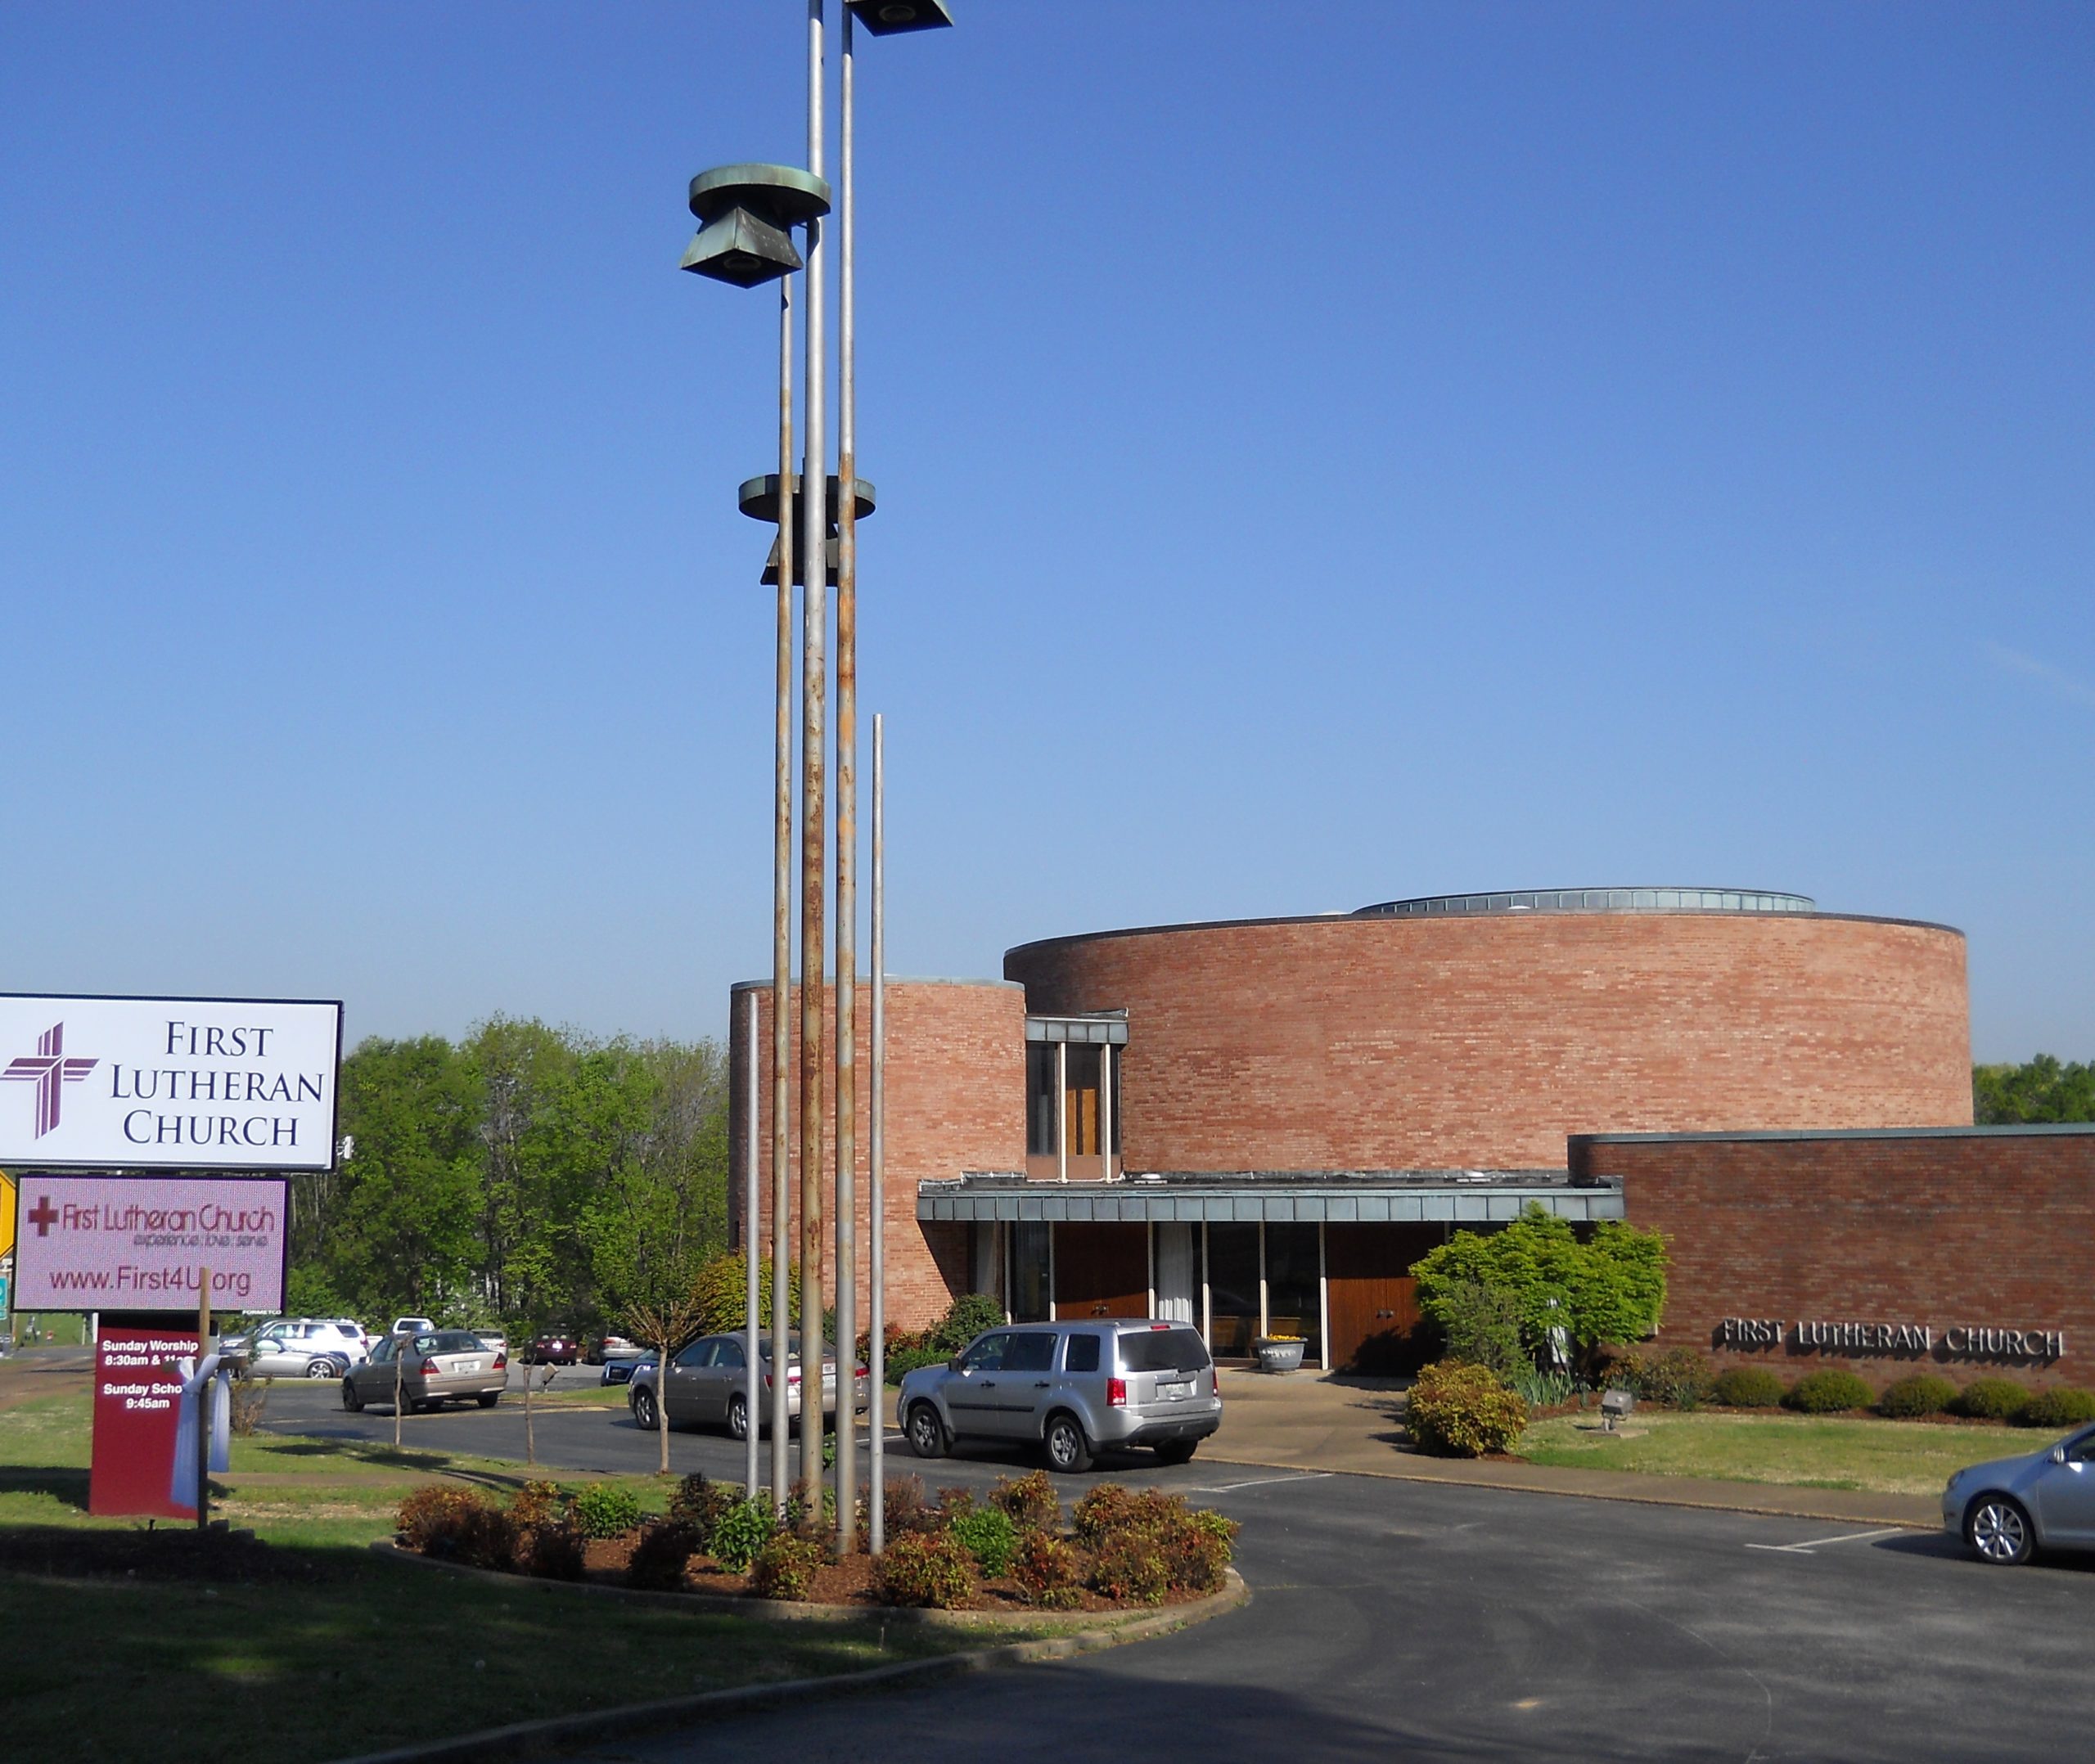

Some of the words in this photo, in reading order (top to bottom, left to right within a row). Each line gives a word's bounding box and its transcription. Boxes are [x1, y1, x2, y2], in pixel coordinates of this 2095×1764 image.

[165, 1020, 274, 1057] FIRST
[109, 1063, 326, 1103] LUTHERAN
[123, 1109, 300, 1146] CHURCH
[63, 1204, 99, 1229] First
[104, 1204, 196, 1231] Lutheran
[199, 1204, 275, 1231] Church
[49, 1267, 250, 1297] www.First4Uorg
[102, 1340, 148, 1353] Sunday
[149, 1340, 199, 1353] Worship
[1723, 1317, 1786, 1343] FIRST
[1798, 1321, 1931, 1351] LUTHERAN
[1945, 1326, 2064, 1357] CHURCH
[105, 1355, 148, 1366] 8:30am
[151, 1354, 160, 1366] &
[103, 1384, 149, 1397] Sunday
[126, 1397, 170, 1408] 9:45am
